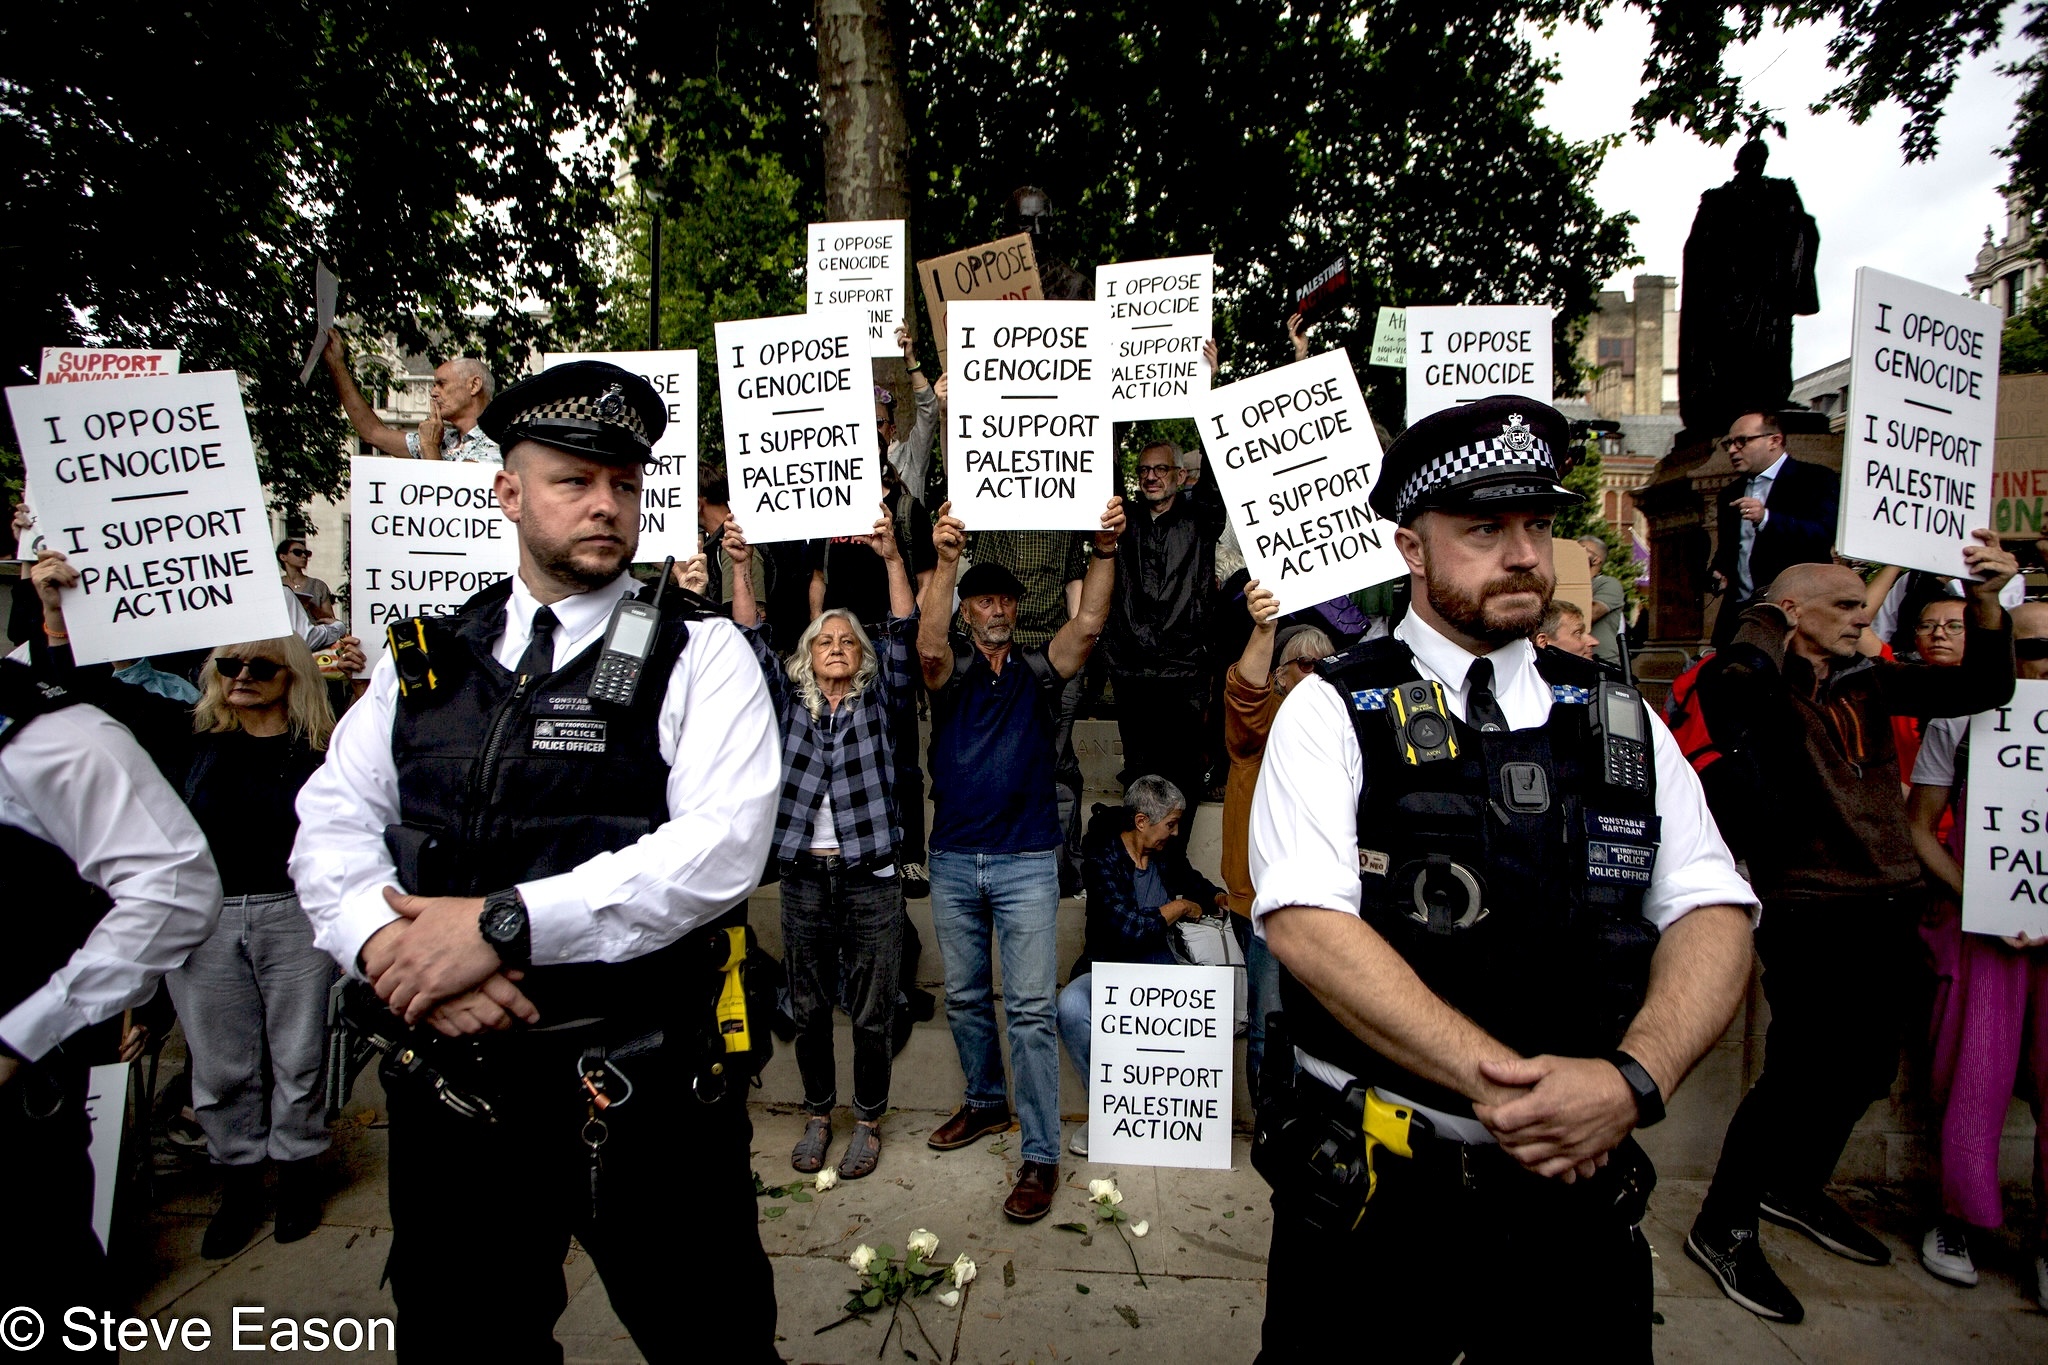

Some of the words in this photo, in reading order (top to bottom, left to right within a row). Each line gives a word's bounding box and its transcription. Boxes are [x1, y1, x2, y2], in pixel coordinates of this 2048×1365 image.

[818, 239, 825, 251] I
[835, 236, 892, 250] OPPOSE
[819, 256, 888, 271] GENOCIDE
[932, 269, 943, 302] I
[955, 243, 1032, 294] OPPOSE
[1107, 281, 1117, 297] I
[1126, 274, 1201, 294] OPPOSE
[1296, 257, 1345, 302] PALESTINE
[814, 291, 823, 304] I
[829, 288, 893, 303] SUPPORT
[962, 328, 975, 348] I
[993, 327, 1089, 348] OPPOSE
[1420, 332, 1433, 354] I
[1447, 331, 1531, 353] OPPOSE
[1875, 303, 1892, 334] I
[1902, 313, 1983, 359] OPPOSE
[732, 346, 744, 368] I
[760, 336, 849, 362] OPPOSE
[1119, 336, 1202, 357] SUPPORT
[58, 352, 162, 372] SUPPORT
[964, 359, 1092, 381] GENOCIDE
[1112, 361, 1197, 382] ALESTINE
[1426, 363, 1535, 385] GENOCIDE
[1875, 348, 1982, 400] GENOCIDE
[738, 368, 851, 399] GENOCIDE
[1112, 380, 1188, 400] ACTION
[1211, 414, 1229, 440] I
[1241, 378, 1342, 428] OPPOSE
[44, 416, 66, 444] I
[84, 403, 220, 440] OPPOSE
[959, 415, 973, 438] I
[982, 415, 1099, 438] SUPPORT
[738, 433, 750, 455] I
[761, 423, 859, 453] SUPPORT
[1225, 409, 1352, 469] GENOCIDE
[1864, 414, 1879, 444] I
[1887, 419, 1982, 467] SUPPORT
[55, 443, 225, 484] GENOCIDE
[742, 458, 863, 488] PALESTINE
[966, 450, 1094, 473] PALESTINE
[369, 482, 387, 504] I
[400, 485, 500, 509] OPPOSE
[976, 476, 1075, 498] ACTION
[1242, 500, 1259, 526] I
[1268, 463, 1371, 516] SUPPORT
[1867, 460, 1976, 510] PALESTINE
[756, 485, 851, 512] ACTION
[371, 515, 502, 539] GENOCIDE
[1873, 496, 1965, 541] ACTION
[63, 526, 89, 554] I
[101, 508, 246, 549] SUPPORT
[1280, 528, 1382, 580] ACTION
[80, 550, 254, 594] PALESTINE
[366, 569, 381, 590] I
[391, 570, 507, 592] SUPPORT
[113, 583, 233, 623] ACTION
[370, 603, 462, 624] PALEST
[1993, 708, 2012, 732] I
[532, 740, 568, 750] POLICE
[566, 742, 606, 752] OFFICER
[1598, 815, 1646, 828] CONSTABLE
[1602, 824, 1642, 836] HARTIGAN
[1983, 806, 2003, 831] I
[1611, 846, 1650, 857] METROPOLITAN
[1617, 854, 1645, 866] POLICE
[1589, 866, 1620, 878] POLICE
[1622, 870, 1649, 881] OFFICER
[1104, 986, 1119, 1005] I
[1130, 988, 1216, 1010] OPPOSE
[1101, 1015, 1217, 1038] GENOCIDE
[1100, 1063, 1112, 1084] I
[1123, 1064, 1223, 1089] SUPPORT
[1103, 1095, 1218, 1119] PALESTINE
[1112, 1118, 1202, 1142] ACTION
